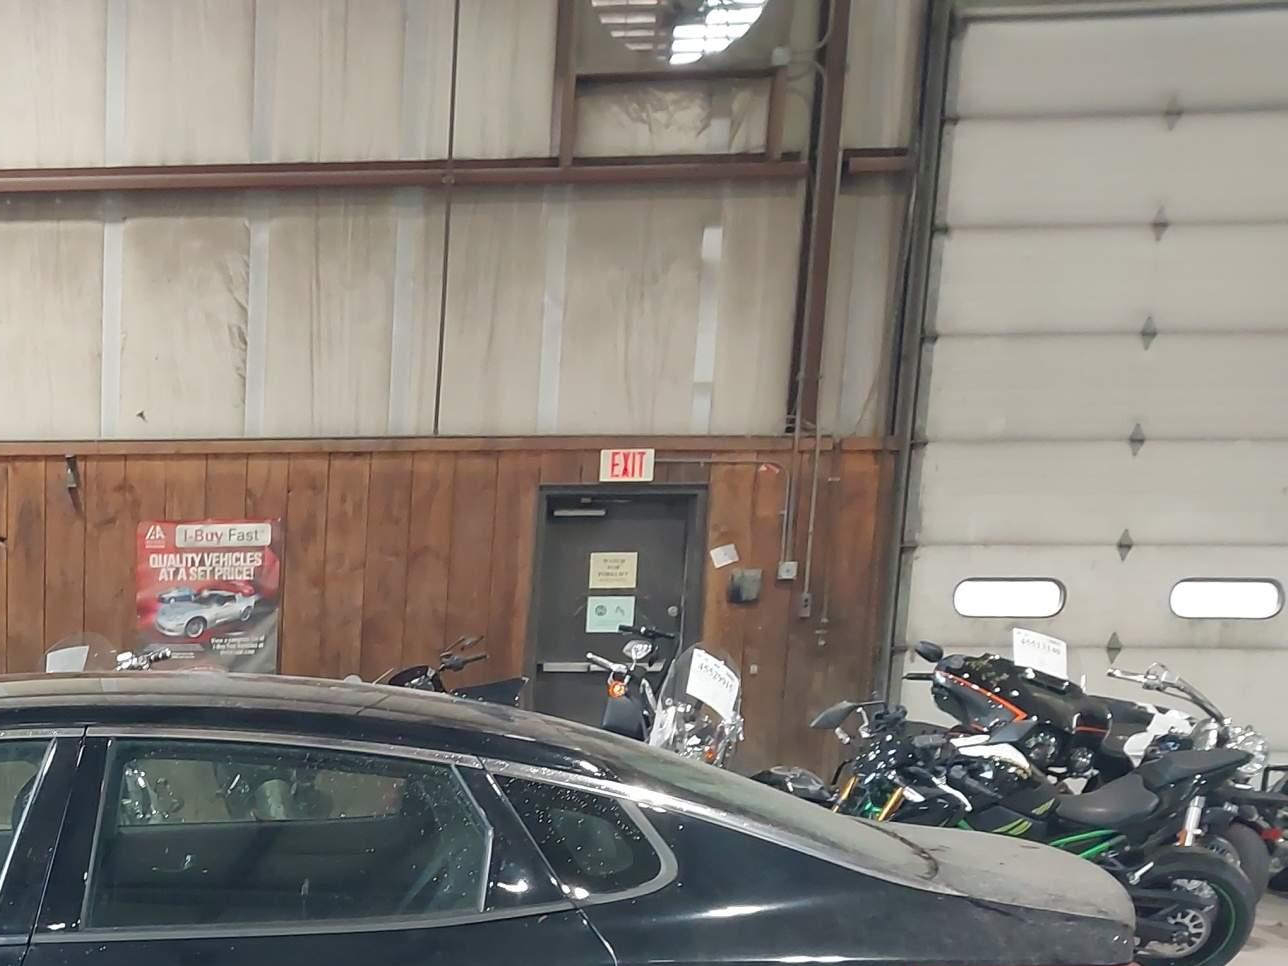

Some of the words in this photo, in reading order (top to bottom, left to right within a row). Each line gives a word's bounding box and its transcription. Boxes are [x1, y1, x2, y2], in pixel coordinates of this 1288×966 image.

[610, 451, 646, 478] EXIT
[184, 529, 223, 543] I-Buy
[229, 528, 259, 542] Fast
[149, 553, 204, 568] QUALITY
[204, 552, 262, 567] VEHICLES
[159, 568, 177, 581] AT
[177, 568, 187, 581] A
[189, 567, 212, 580] SET
[215, 566, 254, 580] PRICE!
